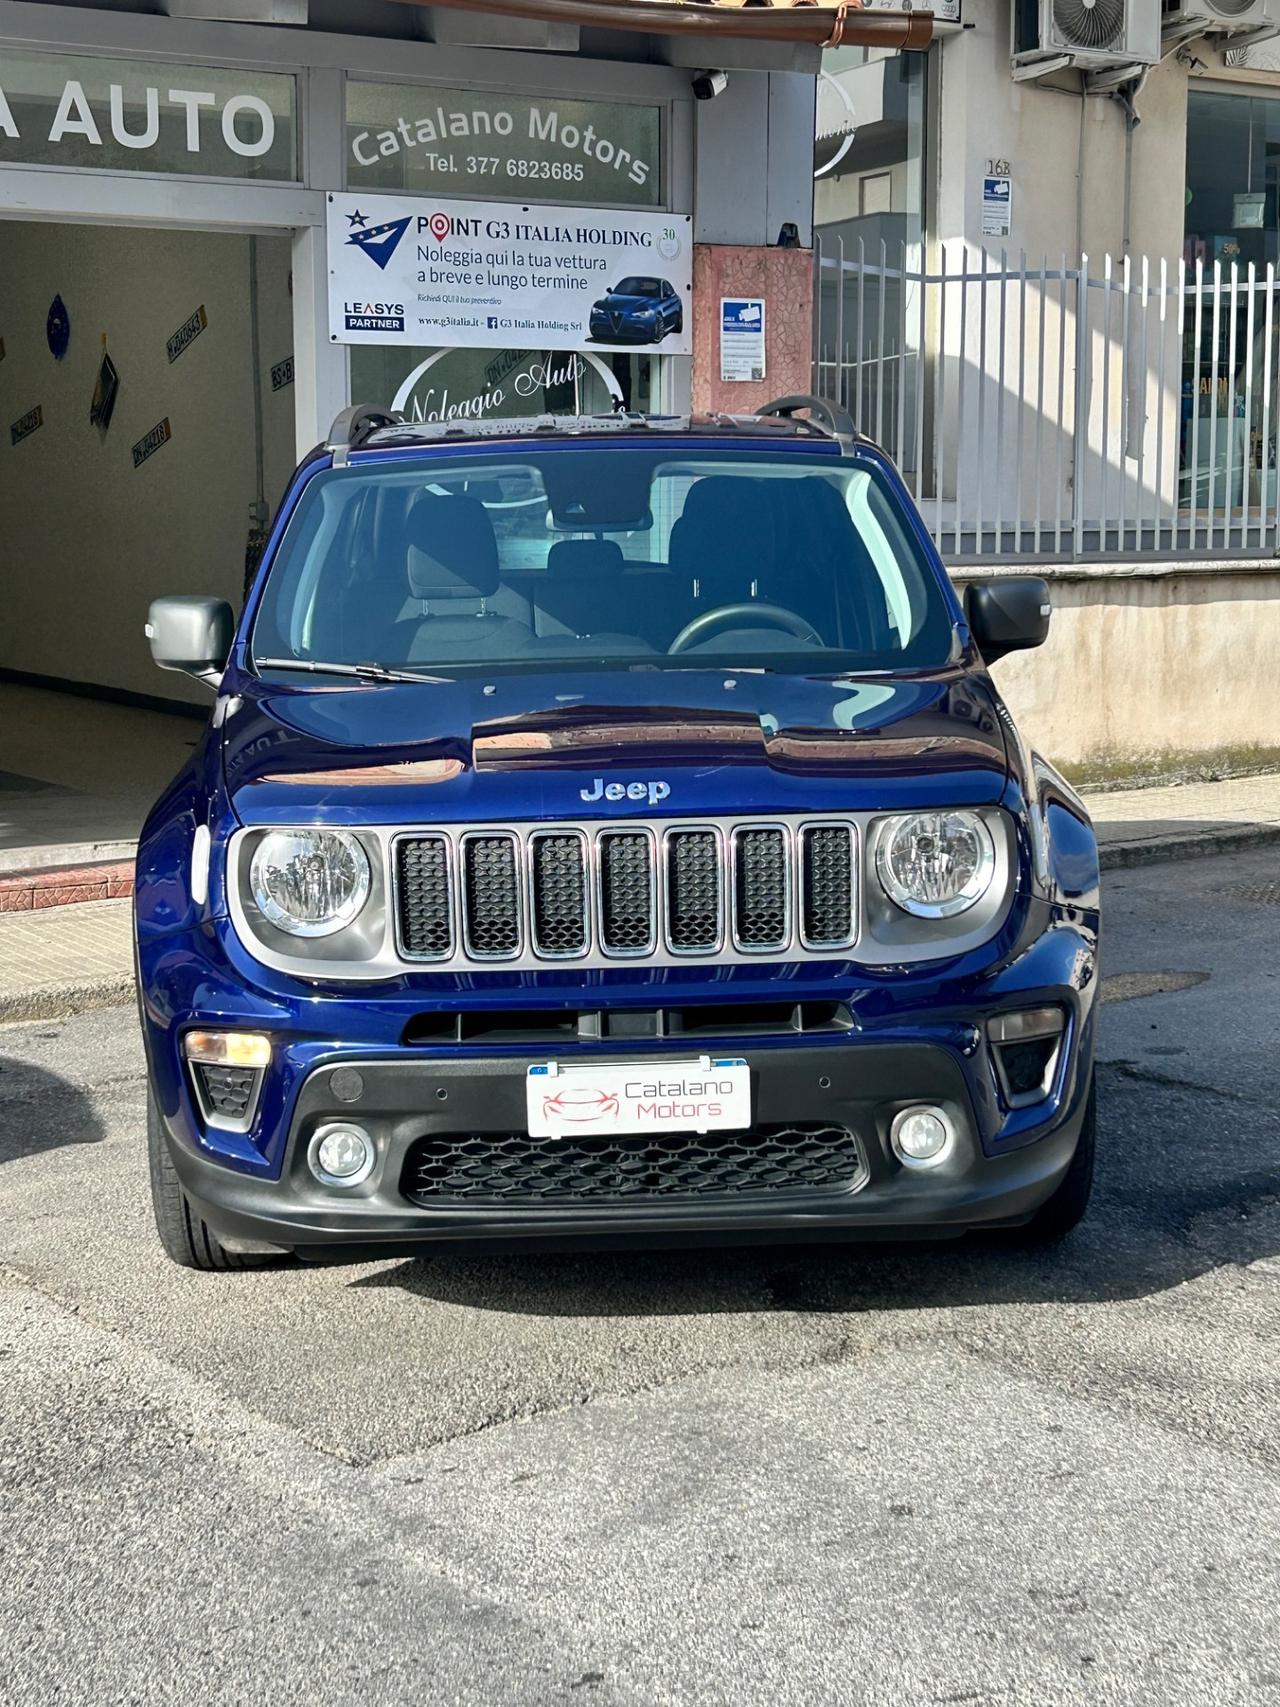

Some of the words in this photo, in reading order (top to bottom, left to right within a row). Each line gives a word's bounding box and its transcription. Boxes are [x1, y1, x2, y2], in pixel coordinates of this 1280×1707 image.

[48, 80, 275, 157] AUTO
[351, 107, 514, 166] Catalano
[528, 107, 651, 185] Motors
[425, 153, 458, 173] Tel.
[466, 156, 500, 176] 377
[506, 159, 584, 182] 6823685
[988, 159, 1010, 176] 16B
[417, 213, 482, 242] POINT
[486, 220, 510, 239] G3
[515, 224, 573, 243] ITALIA
[576, 227, 652, 247] HOLDING
[662, 228, 675, 240] 30
[417, 245, 482, 267] Noleggia
[486, 250, 508, 268] qui
[512, 250, 525, 266] la
[528, 252, 552, 267] tua
[555, 254, 607, 270] vettura
[417, 270, 426, 282] a
[430, 266, 472, 284] breve
[475, 273, 484, 285] e
[488, 270, 528, 290] lungo
[531, 273, 588, 290] termine
[344, 302, 404, 315] LEASYS
[349, 318, 400, 329] PARTNER
[418, 316, 479, 328] www.g3italia.it
[500, 318, 513, 328] G3
[514, 319, 535, 329] Italia
[537, 320, 569, 331] Holding
[570, 321, 582, 331] Srl
[580, 778, 671, 805] Jeep
[624, 1079, 733, 1099] Catalano
[637, 1101, 723, 1120] Motors
